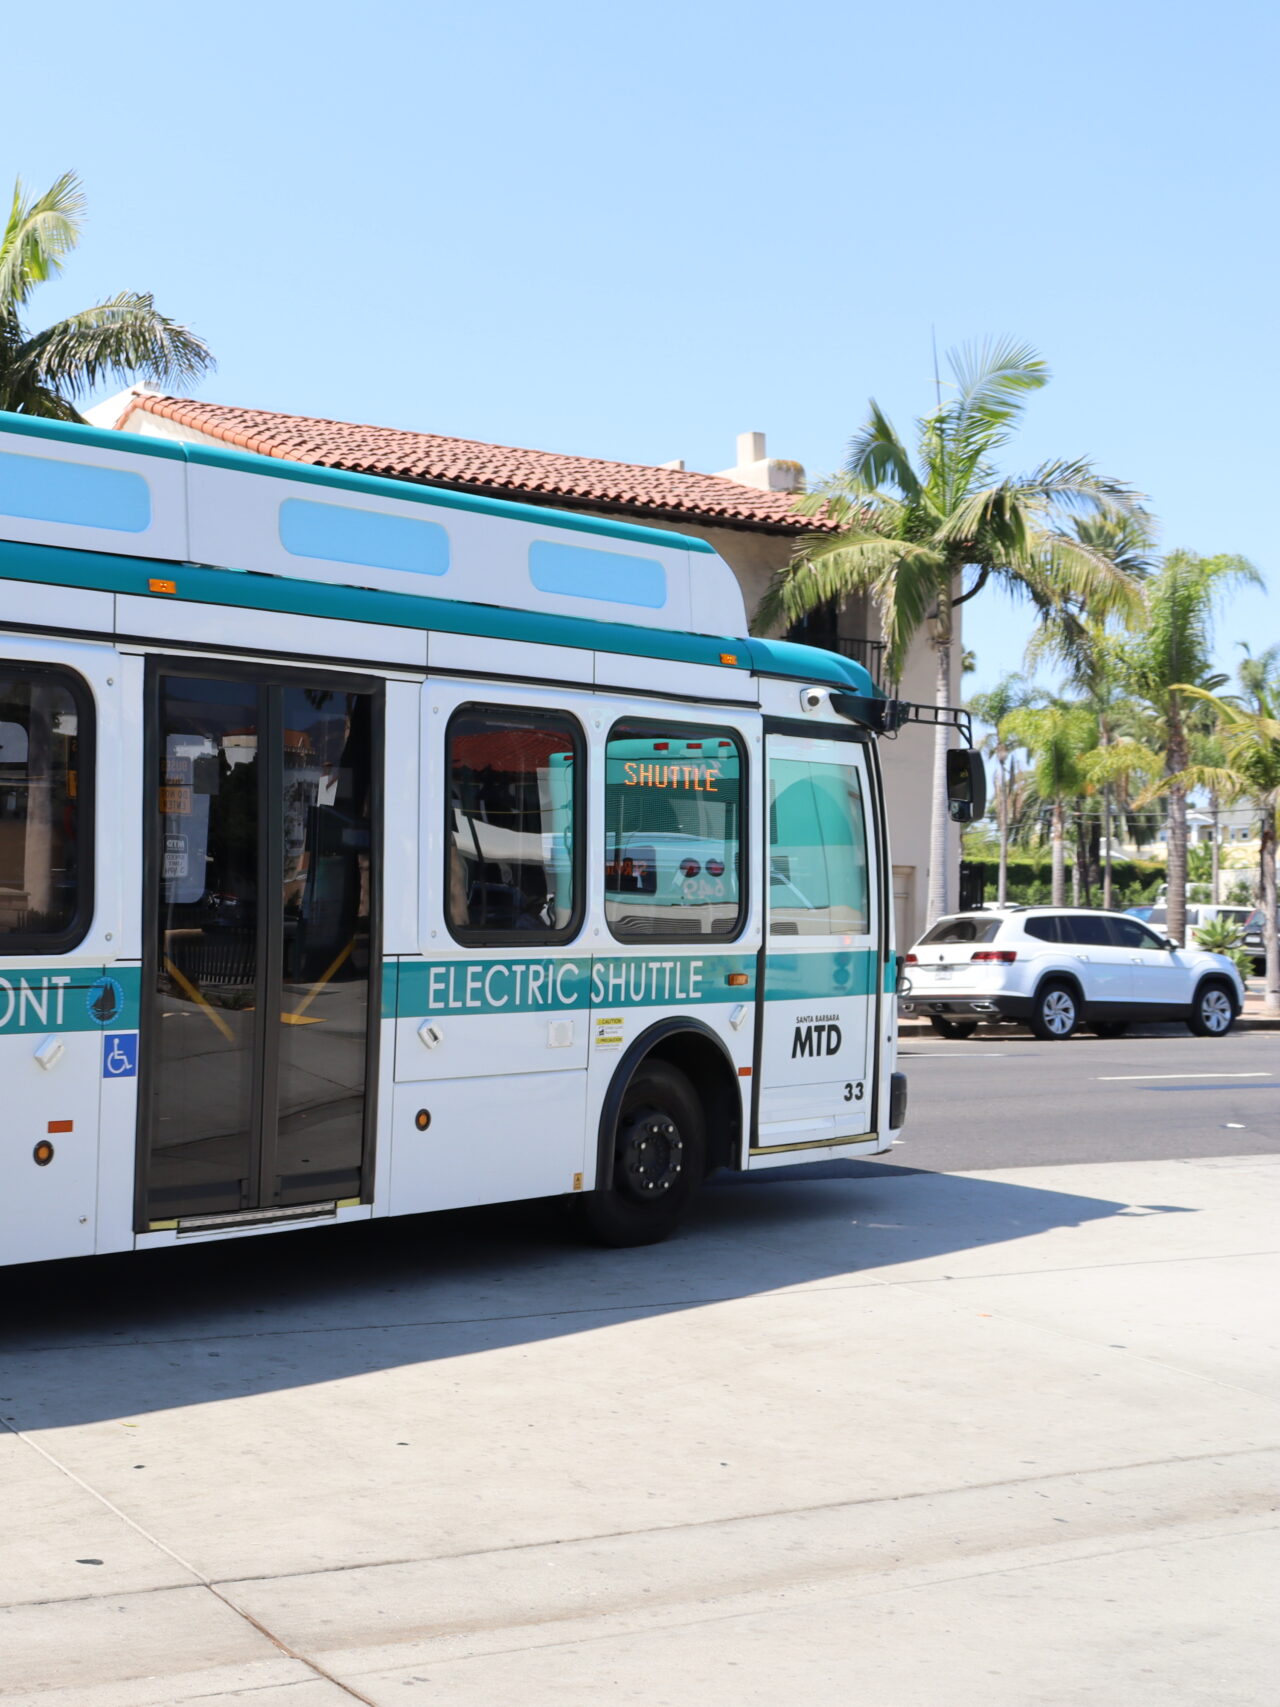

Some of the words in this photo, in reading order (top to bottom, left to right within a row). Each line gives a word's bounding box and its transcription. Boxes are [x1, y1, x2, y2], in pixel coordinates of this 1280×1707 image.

[624, 762, 718, 792] SHUTTLE
[428, 963, 579, 1009] ELECTRIC
[590, 960, 704, 1004] SHUTTLE
[796, 1015, 813, 1024] SANTA
[815, 1014, 840, 1023] BARBARA
[791, 1024, 842, 1059] MTD
[844, 1082, 864, 1102] 33
